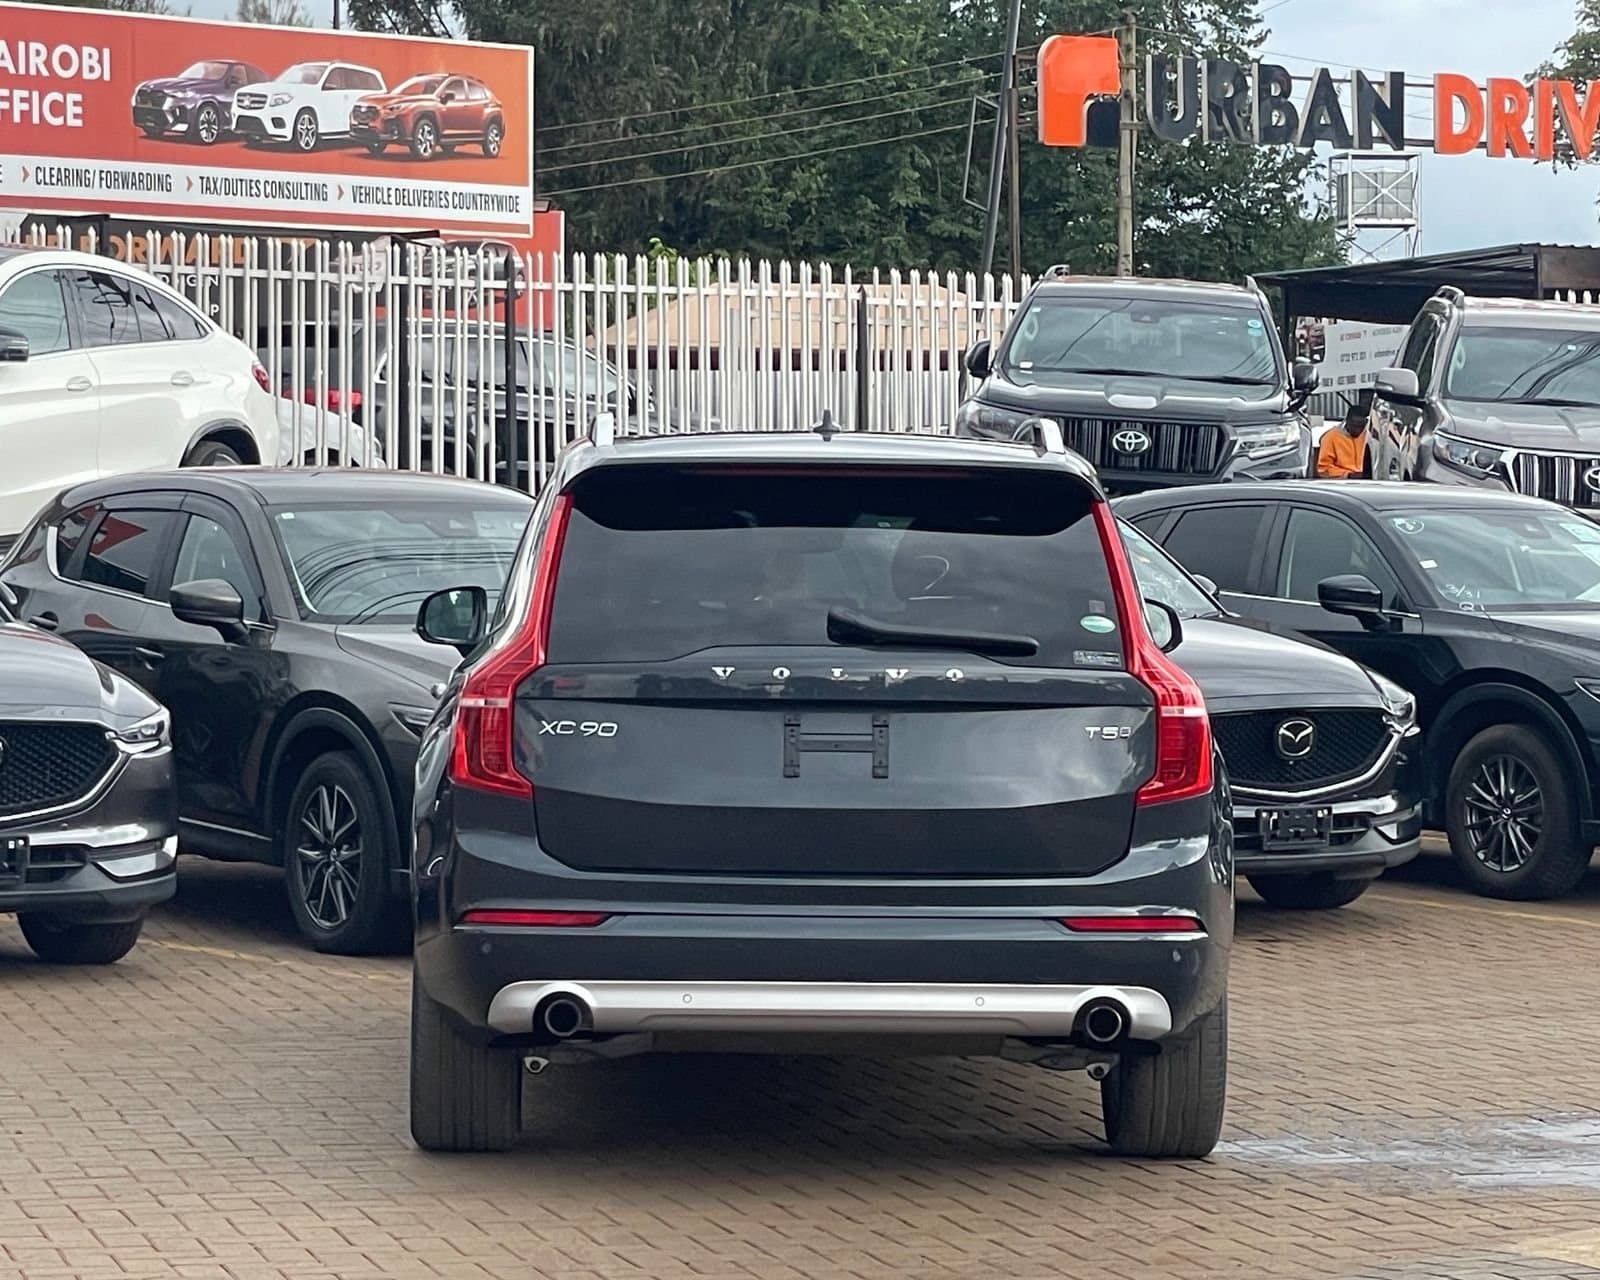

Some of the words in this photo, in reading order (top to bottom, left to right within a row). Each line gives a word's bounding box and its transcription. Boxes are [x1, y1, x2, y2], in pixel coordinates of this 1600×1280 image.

[0, 39, 111, 81] AIROBI
[1145, 55, 1405, 151] URBAN
[1433, 73, 1600, 161] DRIV
[35, 166, 97, 189] CLEARING/
[99, 169, 173, 193] FORWARDING
[199, 175, 261, 198] TAX/DUTIES
[263, 180, 329, 202] CONSULTING
[351, 185, 393, 206] VEHICLE
[394, 187, 450, 209] DELIVERIES
[451, 191, 521, 213] COUNTRYWIDE
[711, 665, 965, 682] VOLVO
[538, 720, 618, 738] XC90
